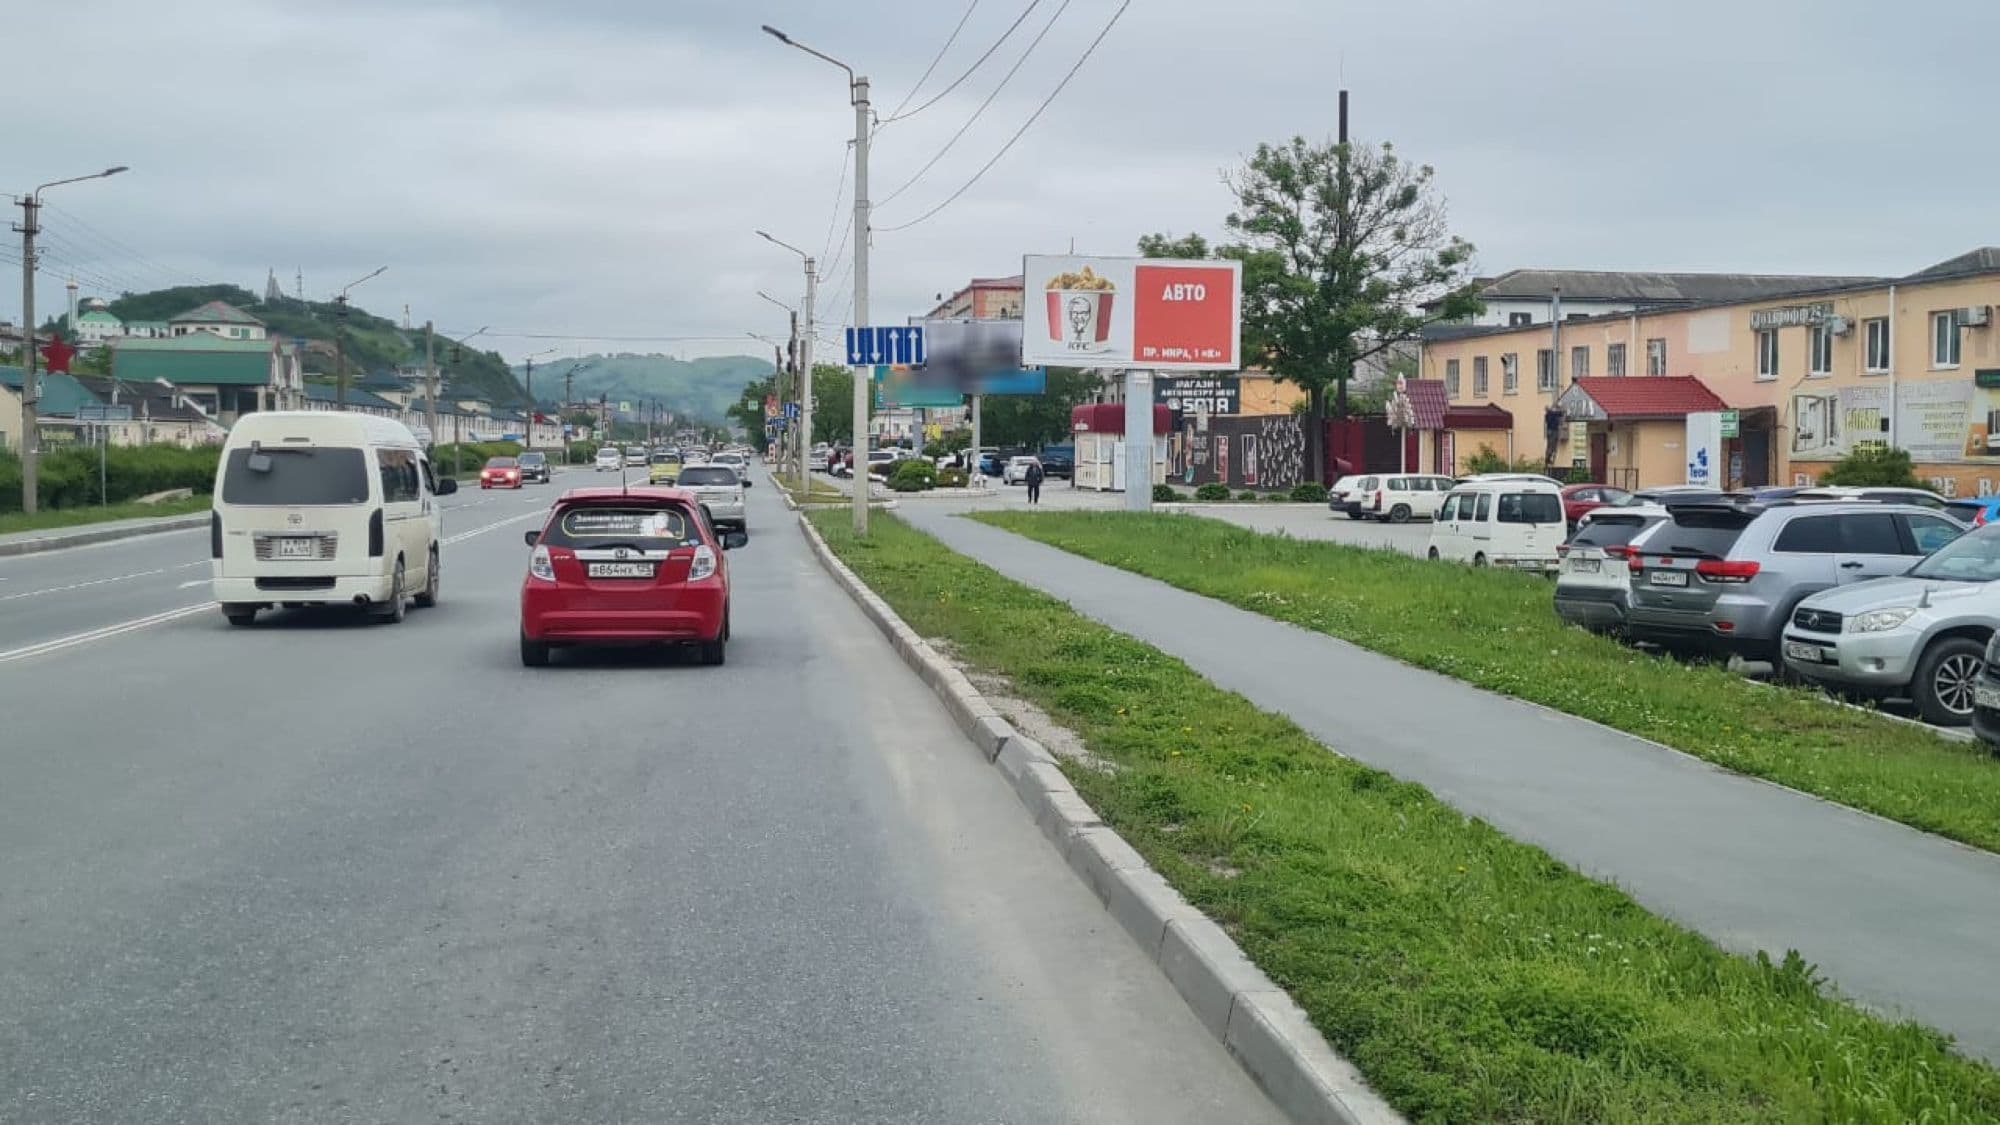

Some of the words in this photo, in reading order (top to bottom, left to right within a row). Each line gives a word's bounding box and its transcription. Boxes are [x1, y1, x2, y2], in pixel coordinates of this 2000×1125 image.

[1162, 283, 1206, 301] АВТО
[1068, 342, 1090, 350] KFC
[1143, 346, 1160, 358] ПР.
[1161, 347, 1192, 360] МИРА,
[1176, 379, 1222, 389] МАГАЗИН
